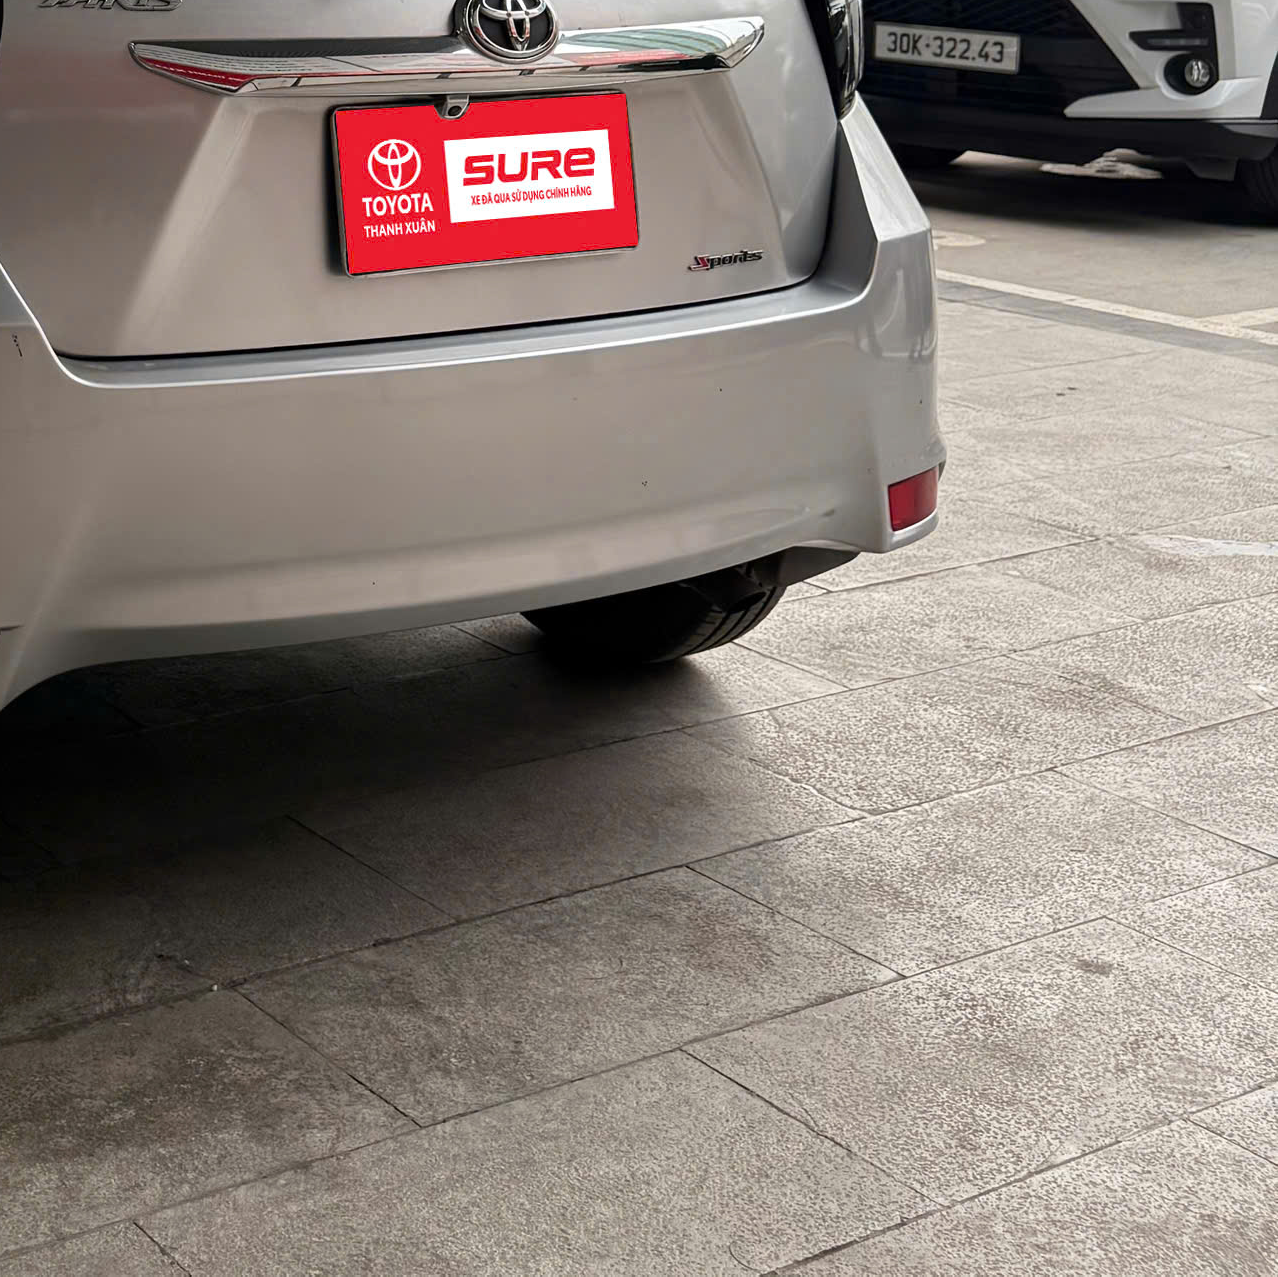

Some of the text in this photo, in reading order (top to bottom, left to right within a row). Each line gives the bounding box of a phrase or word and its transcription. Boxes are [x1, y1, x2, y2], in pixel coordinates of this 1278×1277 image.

[362, 192, 434, 218] TOYOTA
[470, 194, 481, 206] XE
[494, 192, 511, 204] QUA
[522, 189, 545, 204] DỤNG
[545, 186, 570, 200] CHÍNH
[363, 217, 436, 239] THANH XUÂN
